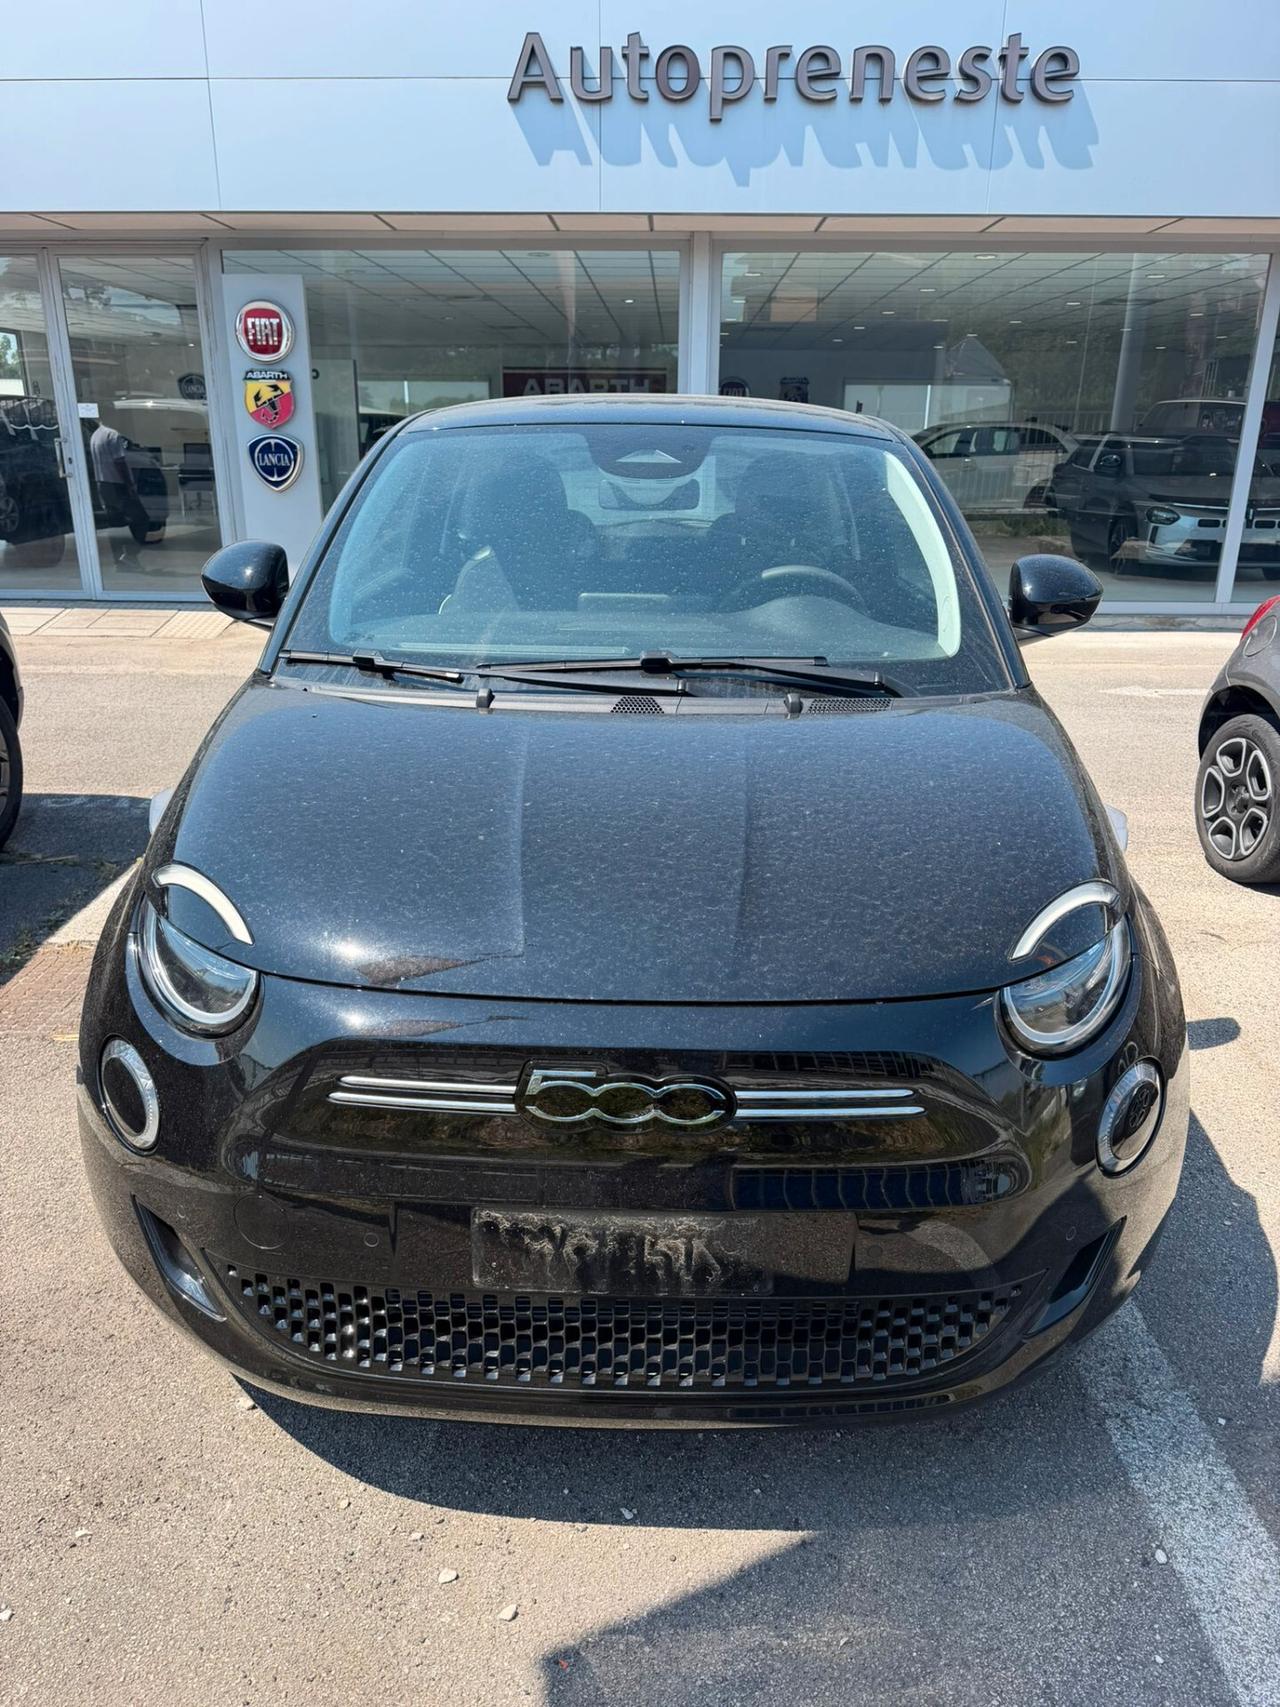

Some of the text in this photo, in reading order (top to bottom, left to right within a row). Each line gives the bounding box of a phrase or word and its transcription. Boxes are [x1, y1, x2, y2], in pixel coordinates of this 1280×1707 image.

[507, 32, 1081, 122] Autopreneste
[246, 317, 280, 345] FIAT
[246, 371, 288, 379] ABARTH
[522, 378, 650, 395] ABARTH
[258, 453, 291, 466] LANCIA
[525, 1069, 726, 1125] 500
